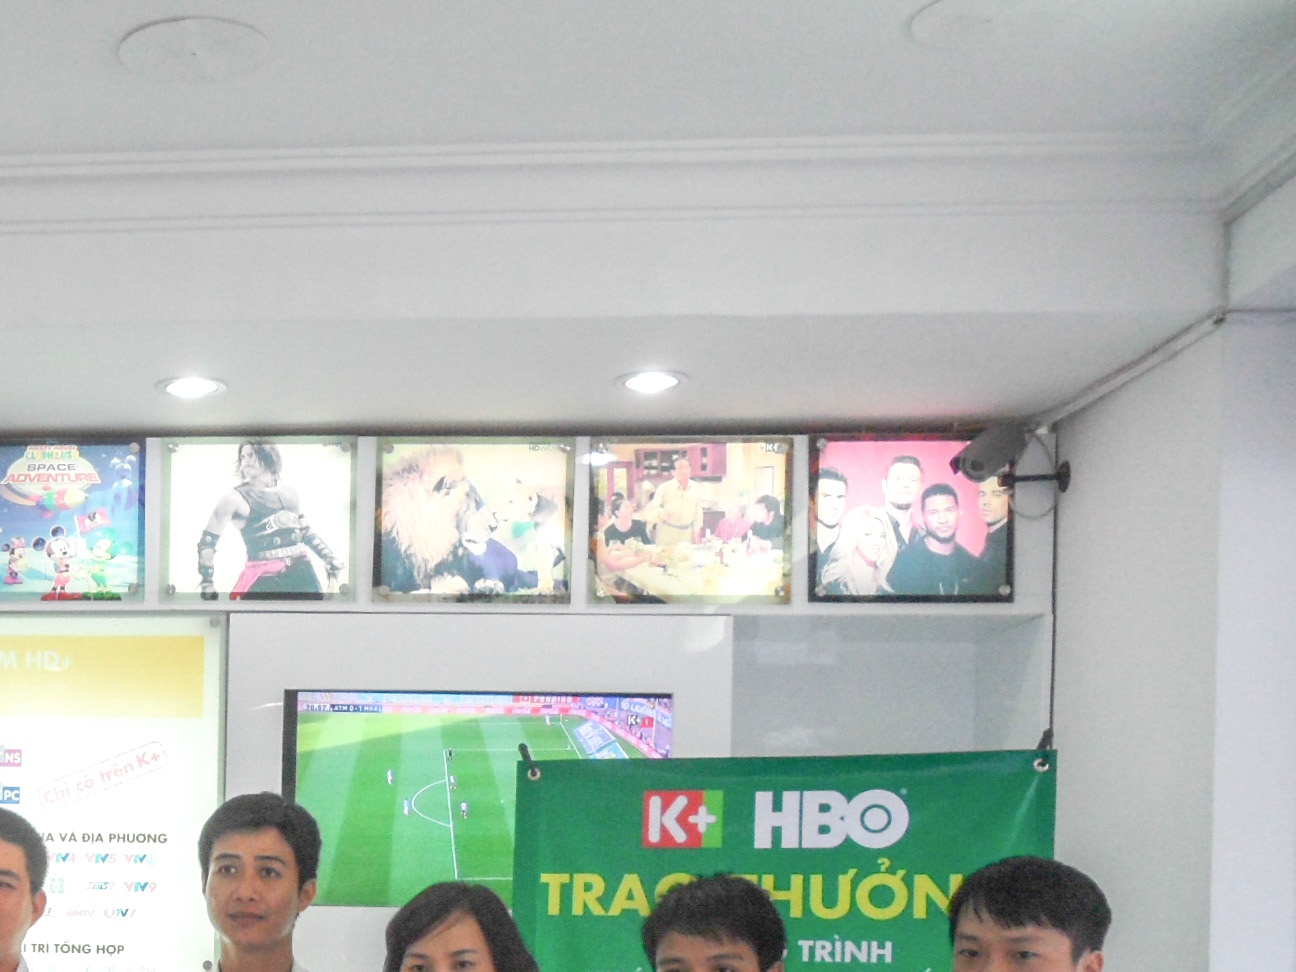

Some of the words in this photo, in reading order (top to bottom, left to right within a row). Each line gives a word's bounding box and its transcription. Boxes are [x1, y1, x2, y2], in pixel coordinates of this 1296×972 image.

[5, 473, 98, 483] ADVENTURE
[27, 463, 76, 472] SPACE
[25, 650, 74, 672] HD+
[647, 793, 718, 845] K+
[754, 789, 910, 849] HBO
[96, 943, 125, 957] HỢP
[798, 935, 893, 964] TRÌNH
